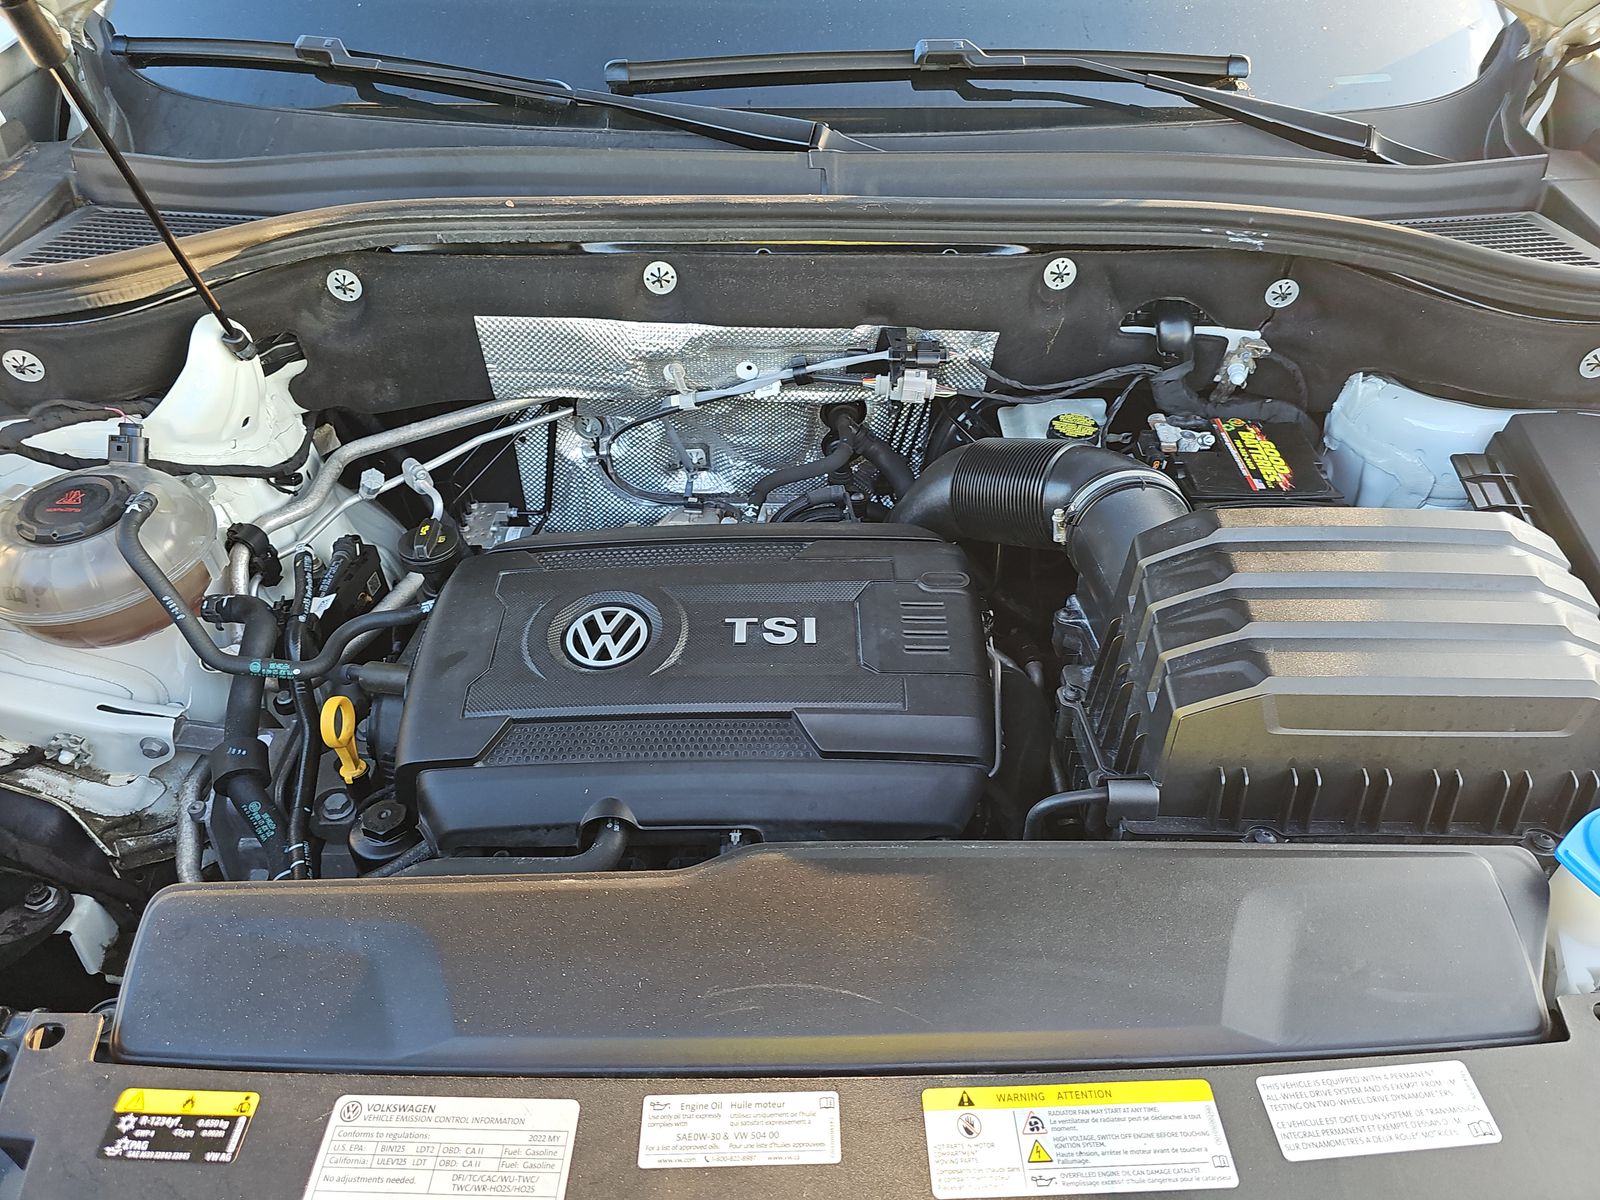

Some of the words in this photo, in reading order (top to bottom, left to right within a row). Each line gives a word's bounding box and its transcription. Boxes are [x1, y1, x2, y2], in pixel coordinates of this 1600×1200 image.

[1238, 431, 1282, 482] BATTERIES
[1260, 440, 1290, 474] GOOD
[724, 616, 818, 646] TSI
[1280, 1081, 1312, 1090] VEHICLE
[1322, 1076, 1360, 1086] EQUIPPED
[1266, 1091, 1308, 1101] ALL-WHEEL
[1309, 1088, 1332, 1098] DRIVE
[1334, 1086, 1362, 1096] SYSTEM
[1390, 1082, 1418, 1090] EXEMPT
[1420, 1080, 1442, 1088] FROM
[996, 1092, 1045, 1102] WARNING
[1057, 1090, 1112, 1100] ATTENTION
[680, 1102, 708, 1112] Engine
[711, 1102, 722, 1110] Oil
[730, 1101, 752, 1109] Huile
[1270, 1102, 1302, 1112] TESTING
[1304, 1101, 1316, 1110] ON
[1366, 1094, 1388, 1104] DRIVE
[366, 1104, 436, 1114] VOLKSWAGEN
[196, 1119, 219, 1128] 0.650
[219, 1119, 230, 1130] kg
[1326, 1116, 1338, 1126] EST
[338, 1130, 374, 1138] Conforms
[386, 1132, 430, 1140] regulations:
[722, 1132, 728, 1140] &
[734, 1132, 748, 1140] VW
[751, 1131, 766, 1140] 504
[768, 1130, 780, 1139] 00
[1321, 1126, 1366, 1136] PERMANENT
[129, 1140, 150, 1150] PAG
[1284, 1142, 1300, 1152] SUR
[1372, 1134, 1394, 1143] DEUX
[205, 1152, 220, 1162] VW
[220, 1152, 232, 1162] AG
[525, 1148, 558, 1156] Gasoline
[329, 1156, 368, 1164] California:
[322, 1174, 334, 1182] No
[336, 1176, 384, 1184] adjustments
[386, 1176, 416, 1184] needed.
